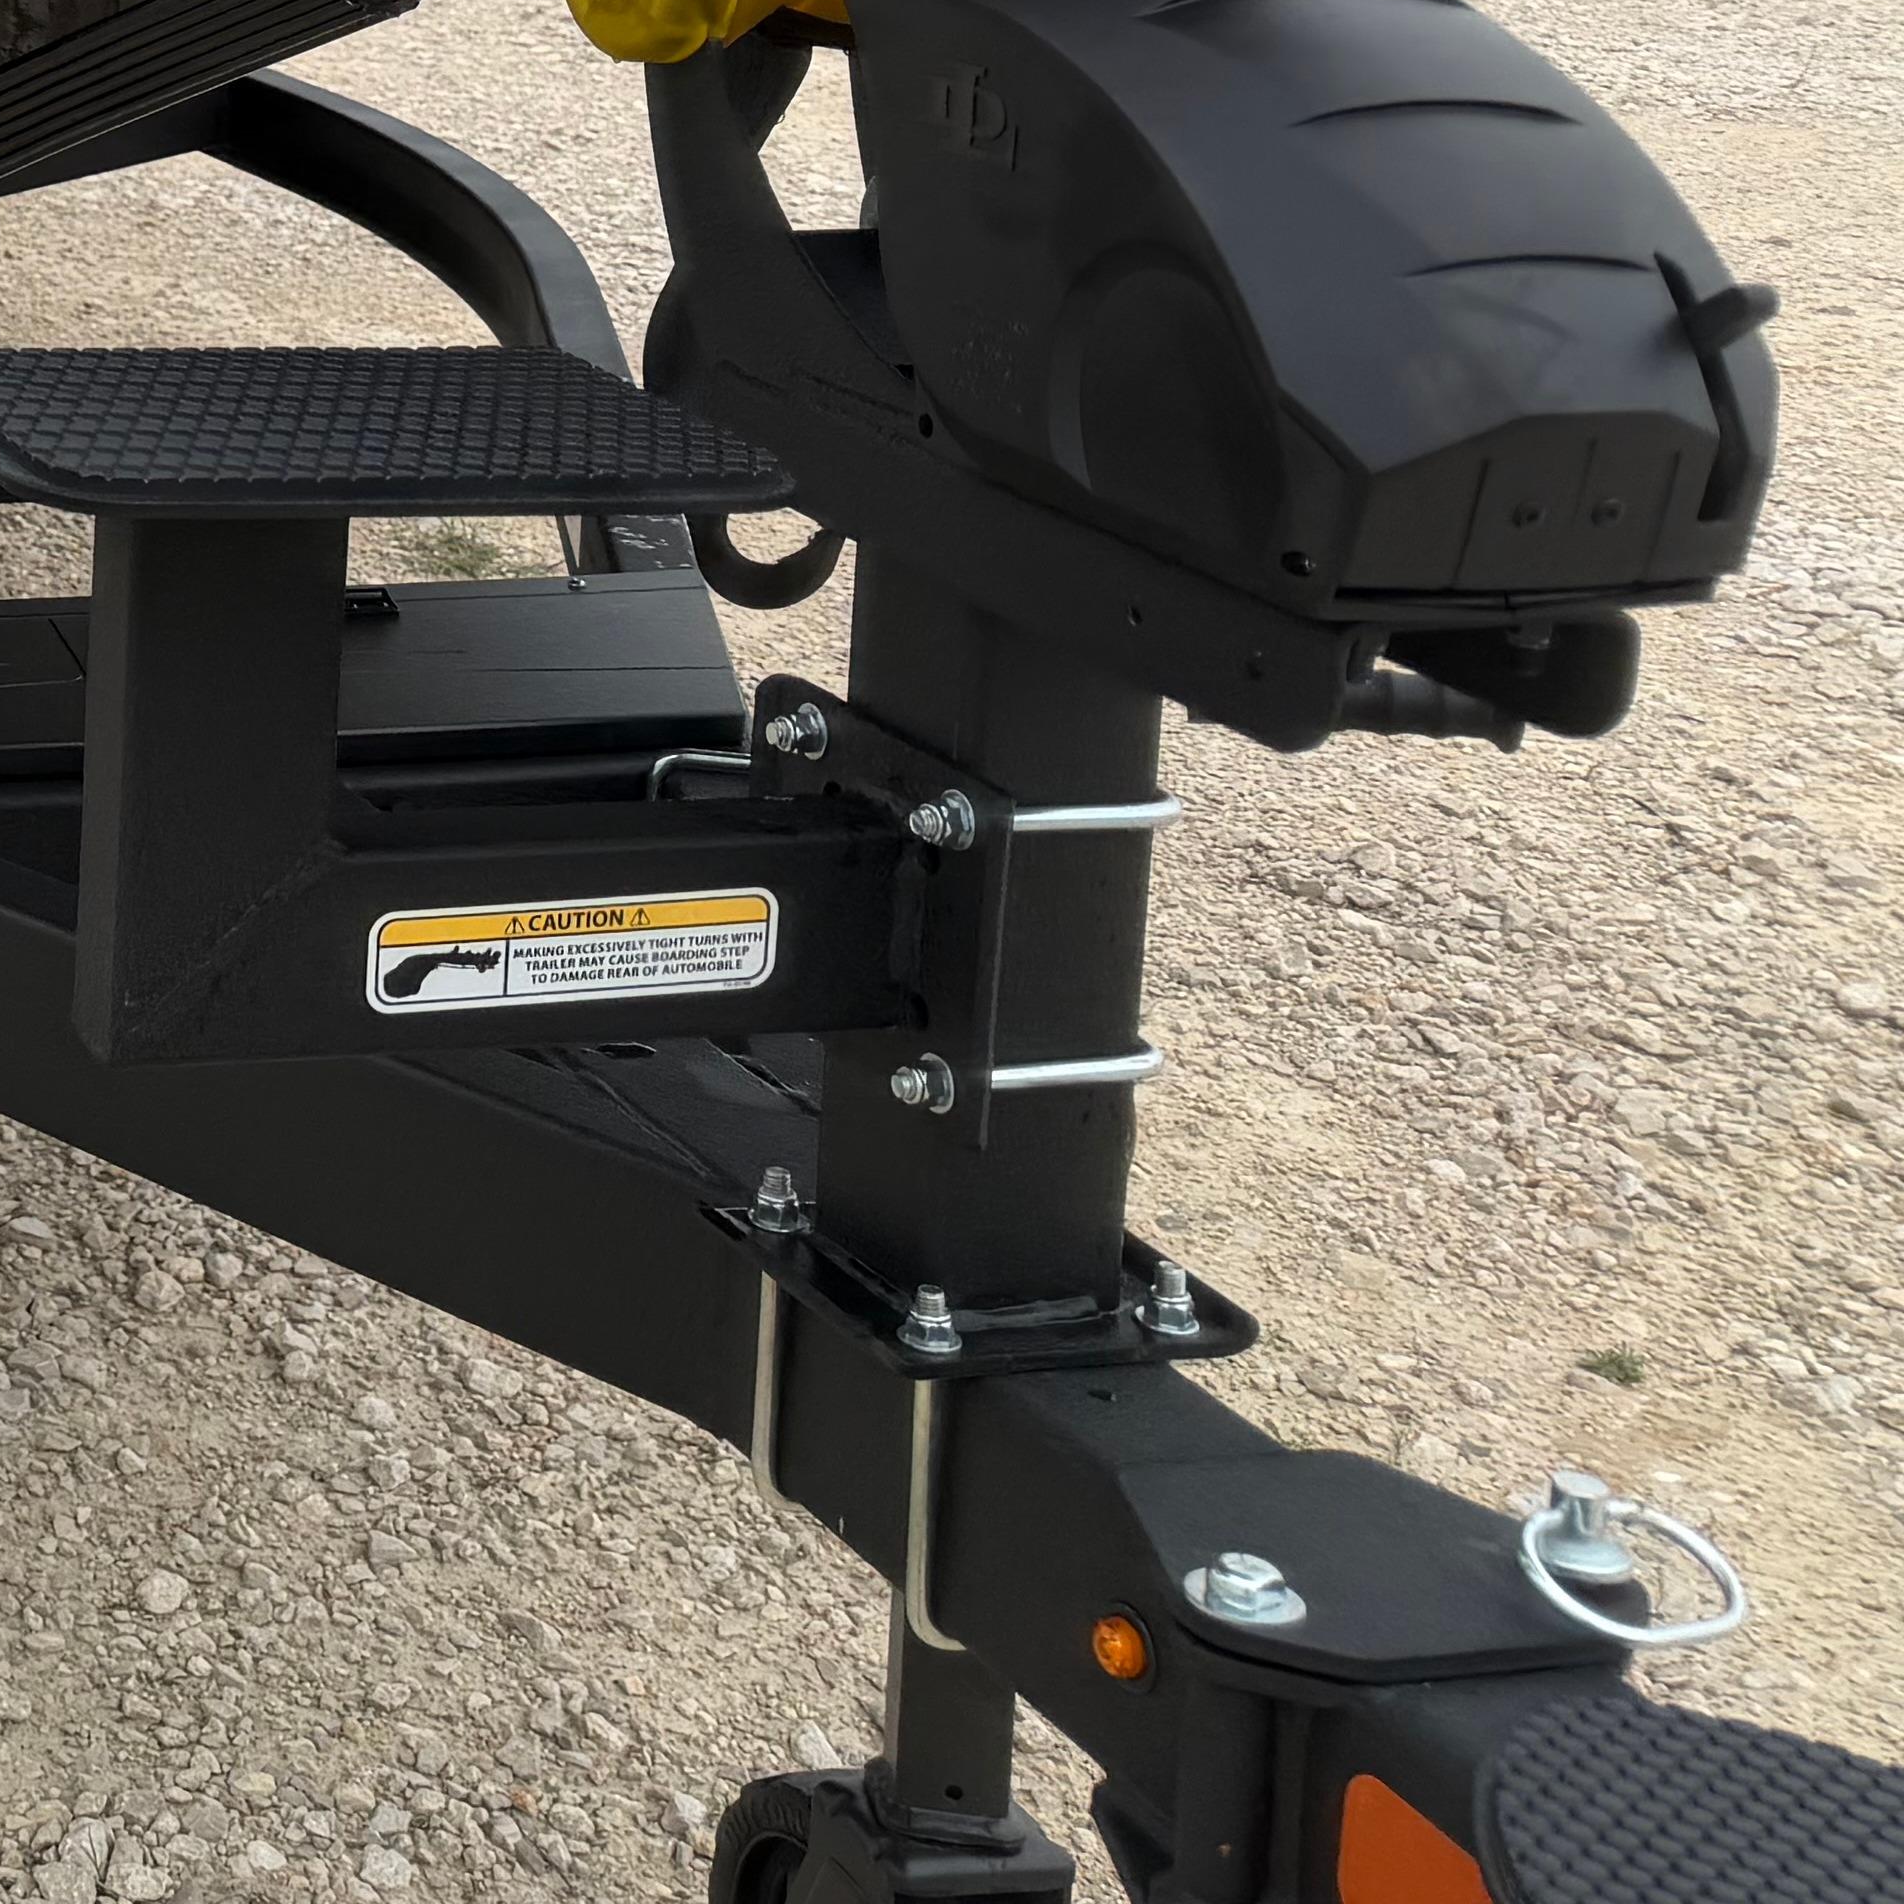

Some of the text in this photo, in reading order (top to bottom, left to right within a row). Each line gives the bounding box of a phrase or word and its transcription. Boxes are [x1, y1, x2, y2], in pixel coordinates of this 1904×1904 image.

[528, 909, 624, 931] CAUTION
[513, 931, 764, 959] MAKING EXCESSIVELY TIGHT TURNS WITH
[525, 945, 750, 972] TRAILER MAY CAUSE BOARDING STEP
[531, 959, 743, 985] TO DAMAGE REAR OF AUTOMOBILE
